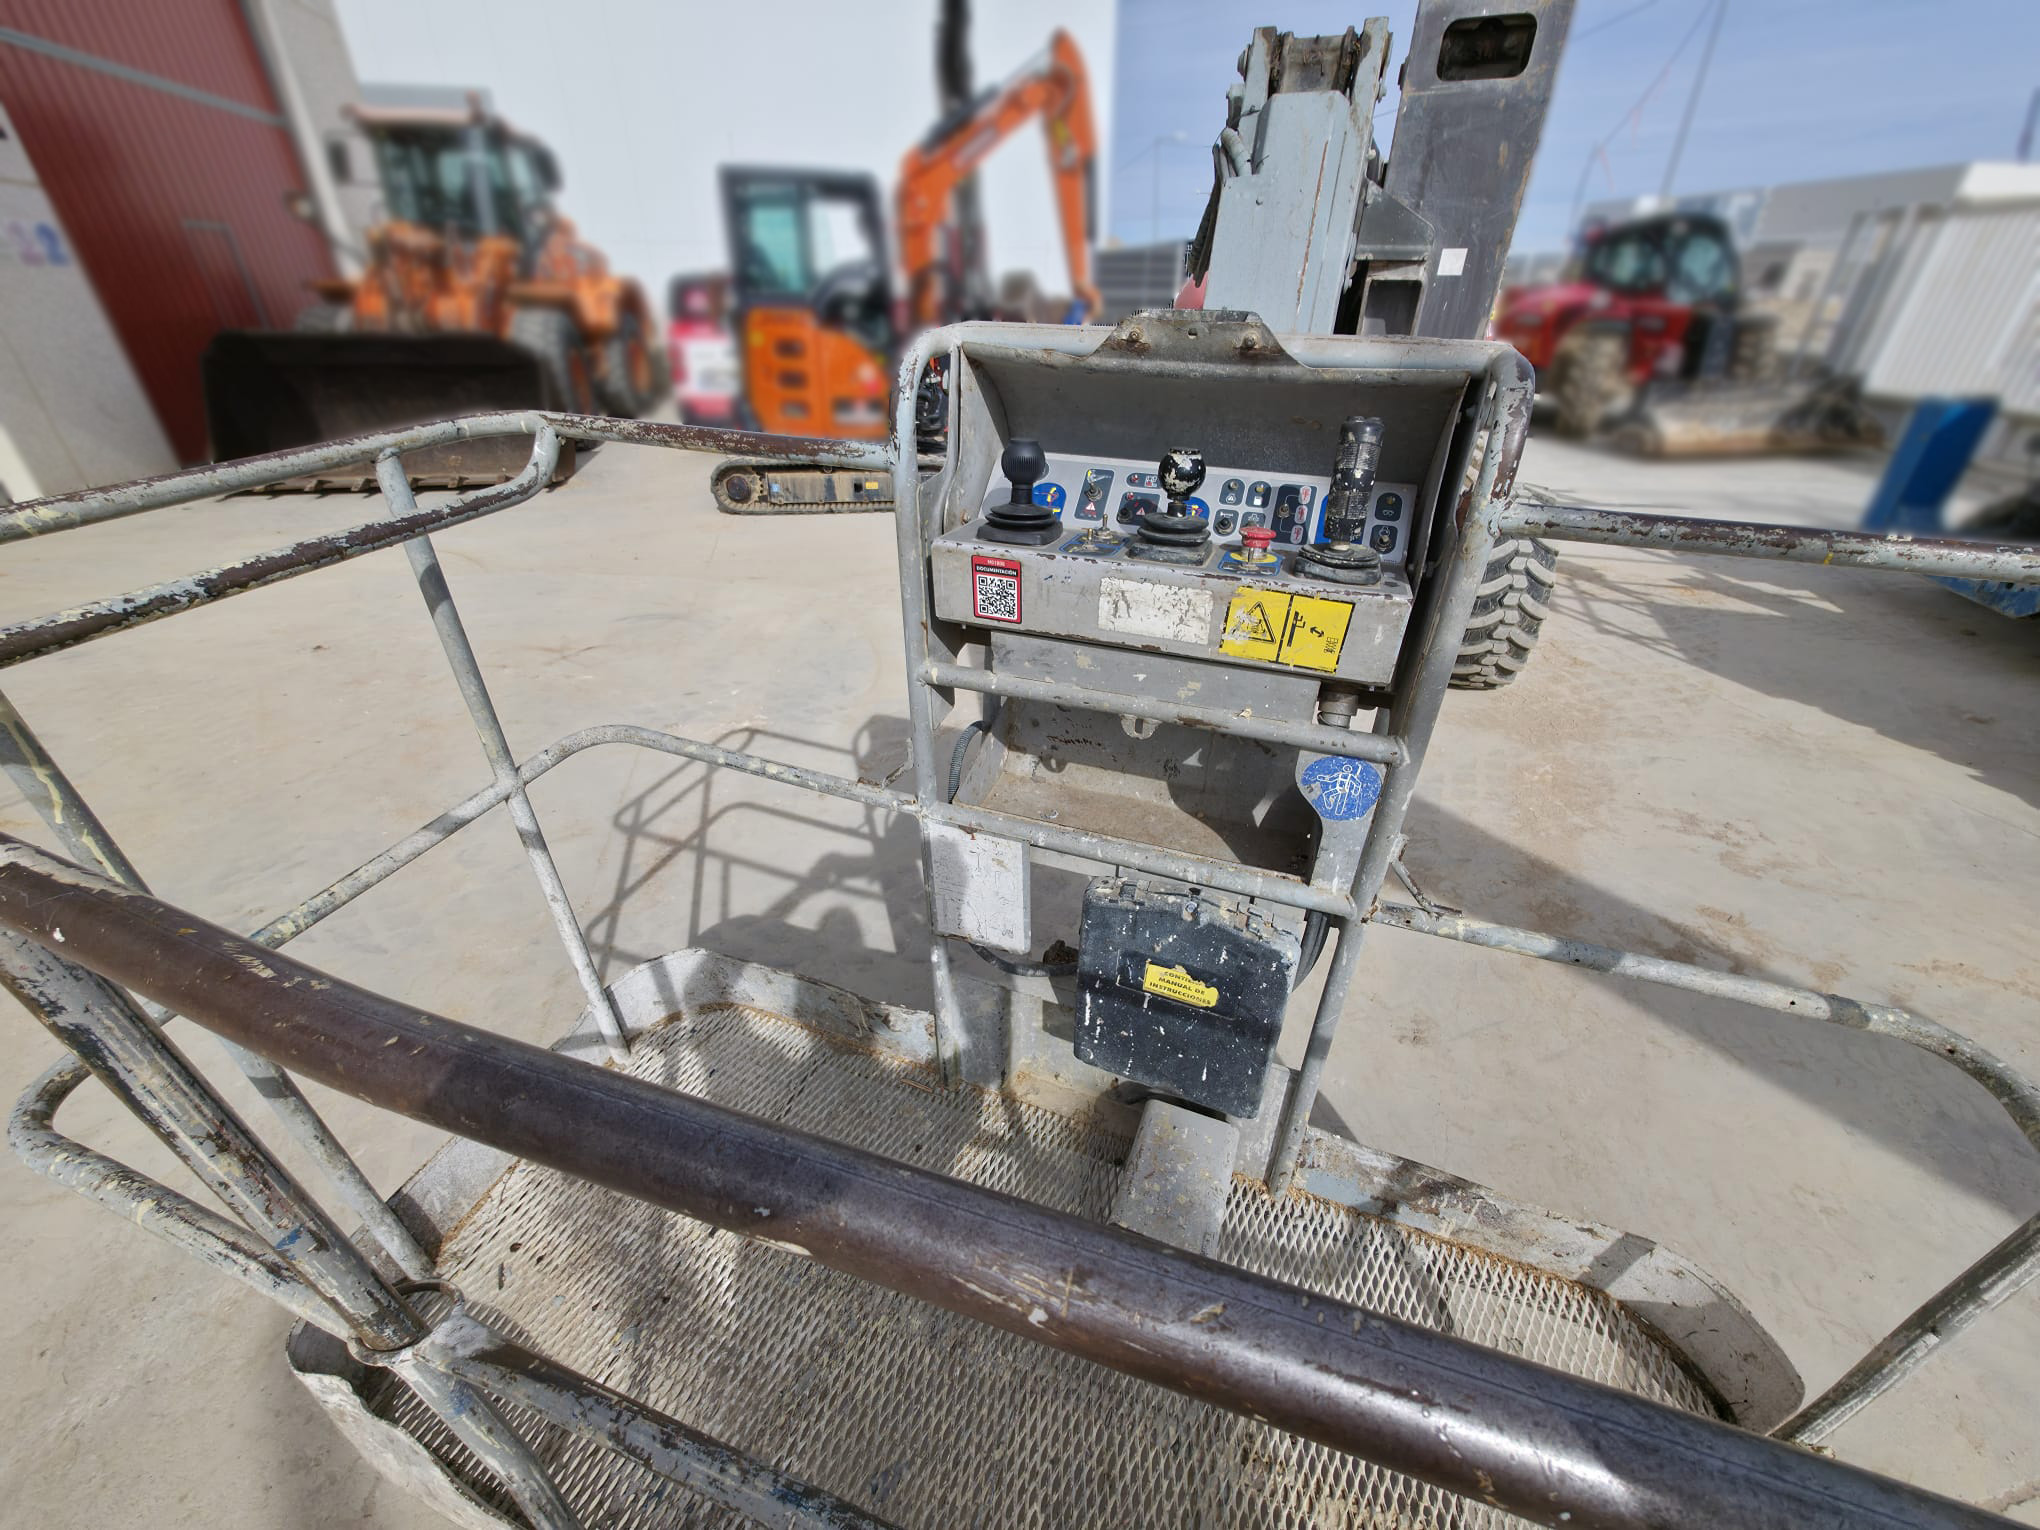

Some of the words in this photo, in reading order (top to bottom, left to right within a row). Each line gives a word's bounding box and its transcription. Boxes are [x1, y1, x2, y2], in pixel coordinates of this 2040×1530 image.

[1149, 981, 1212, 1005] INSTRUCCIONES
[1158, 977, 1193, 991] MANUAL
[1194, 987, 1206, 995] DE
